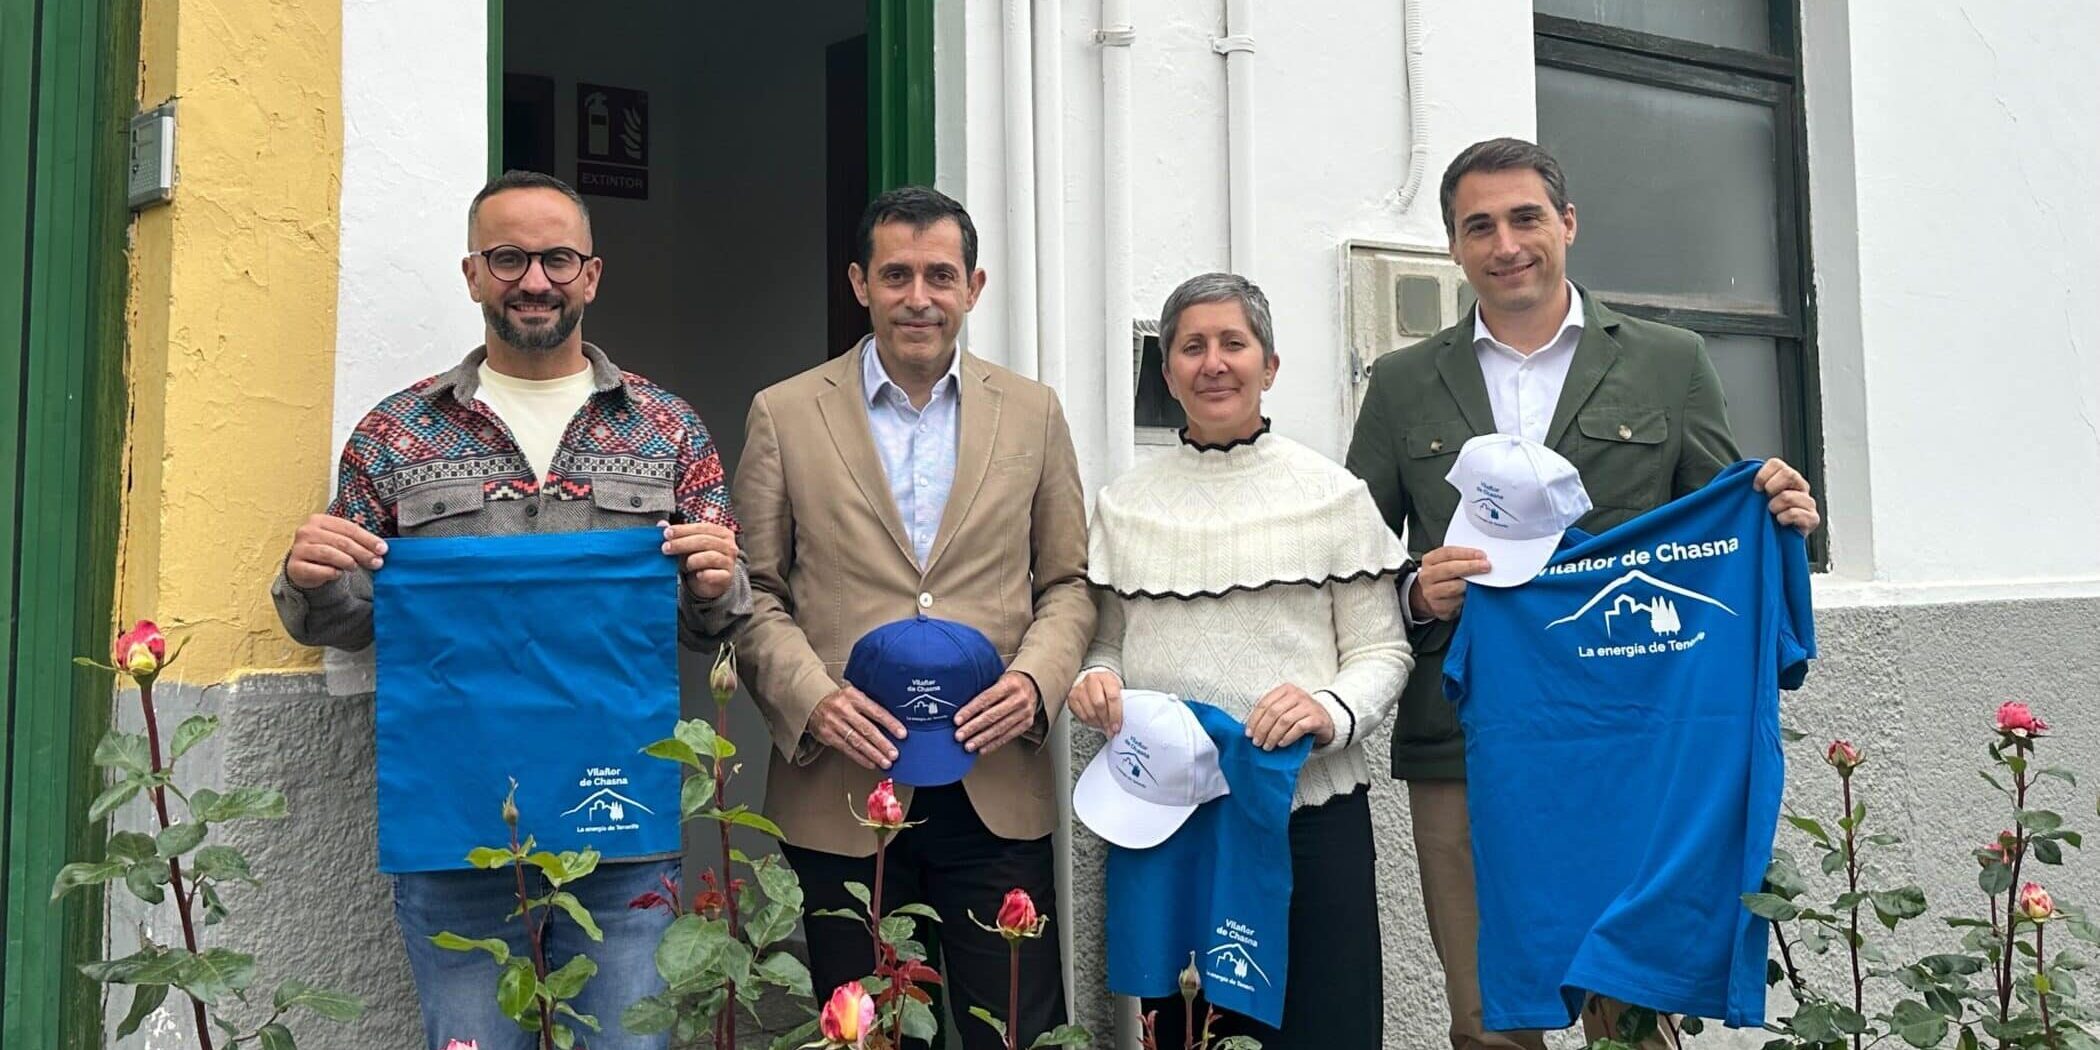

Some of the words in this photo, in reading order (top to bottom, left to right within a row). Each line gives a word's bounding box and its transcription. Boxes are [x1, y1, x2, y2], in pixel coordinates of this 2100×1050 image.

[583, 173, 642, 188] EXTINTOR
[1621, 549, 1650, 567] de
[1655, 537, 1739, 563] Chasna
[1578, 646, 1595, 658] La
[1648, 641, 1666, 653] de
[586, 767, 621, 777] Vilaflor
[579, 778, 592, 787] de
[594, 777, 628, 786] Chasna
